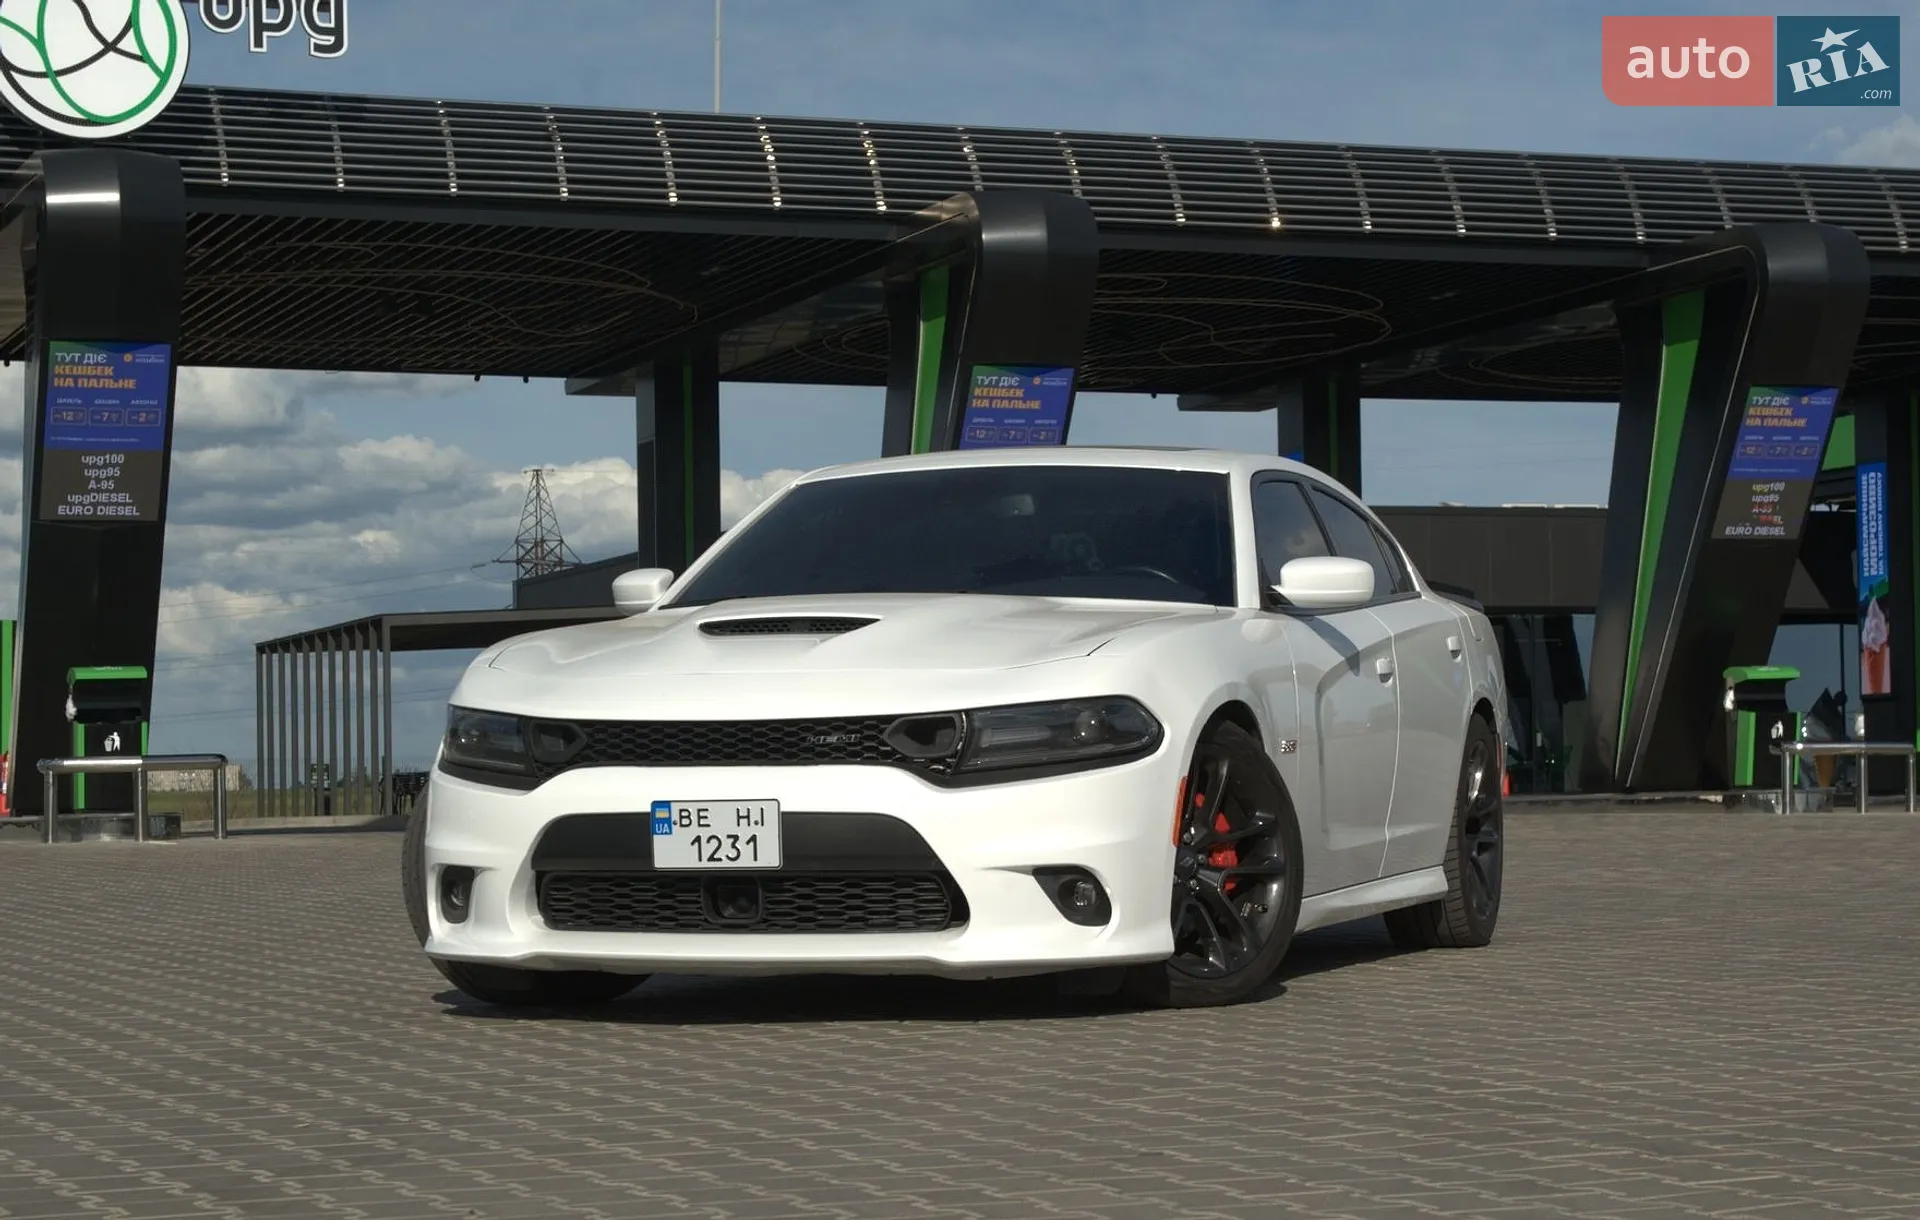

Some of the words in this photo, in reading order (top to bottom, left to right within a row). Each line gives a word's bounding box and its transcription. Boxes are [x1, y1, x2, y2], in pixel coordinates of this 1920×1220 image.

[199, 0, 348, 58] upg
[55, 352, 81, 363] ТУТ
[83, 353, 108, 365] ДІЄ
[54, 365, 115, 376] КЕШБЕК
[53, 377, 75, 388] НА
[77, 378, 137, 389] ПАЛЬНЕ
[977, 376, 997, 386] ТУТ
[999, 376, 1020, 387] ДІЄ
[974, 387, 1025, 398] КЕШБЕК
[972, 398, 989, 408] НА
[992, 399, 1042, 409] ПАЛЬНЕ
[1752, 396, 1770, 405] ТУТ
[1771, 396, 1790, 406] ДІЄ
[1745, 417, 1762, 427] НА
[81, 454, 125, 467] upg100
[84, 467, 121, 479] upg95
[88, 480, 115, 490] A-95
[67, 492, 133, 504] upgDIESEL
[57, 505, 93, 516] EURO
[97, 505, 140, 516] DIESEL
[1725, 526, 1752, 536] EURO
[1753, 526, 1786, 536] DIESEL
[678, 808, 711, 828] BE
[655, 823, 670, 834] UA
[690, 834, 758, 862] 1231
